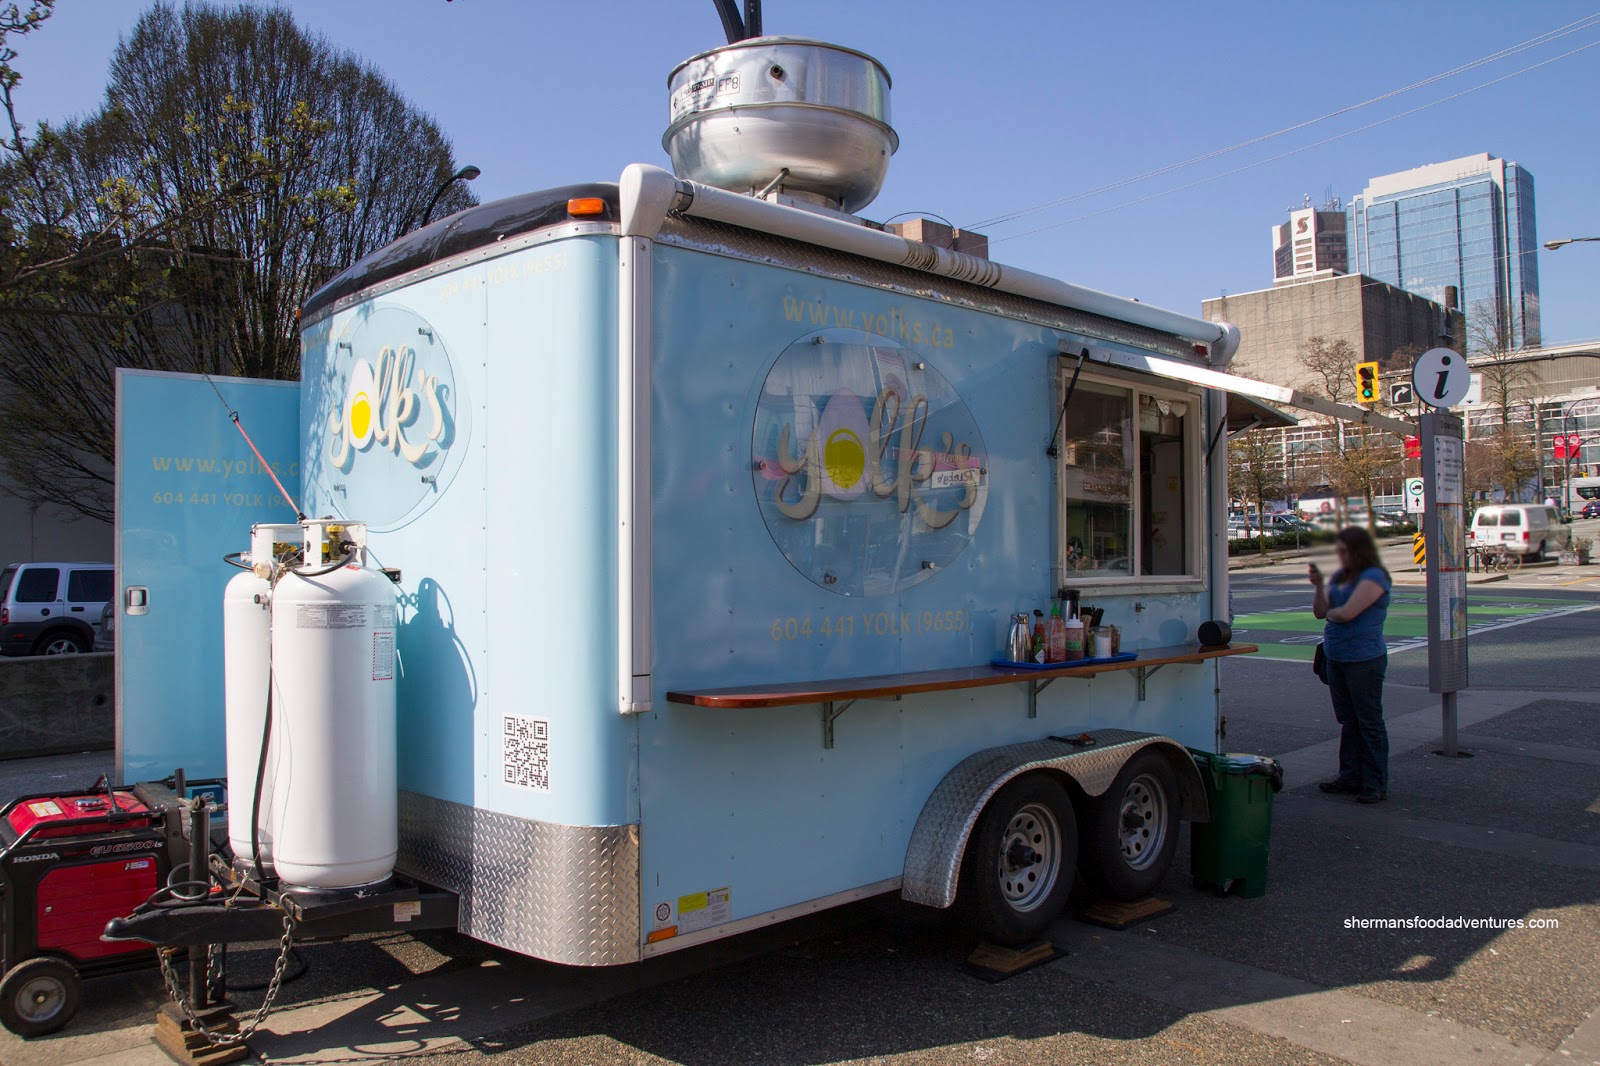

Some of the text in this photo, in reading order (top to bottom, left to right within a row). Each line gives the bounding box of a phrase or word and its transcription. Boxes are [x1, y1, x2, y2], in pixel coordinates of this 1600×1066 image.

[719, 77, 739, 93] EF8
[783, 297, 954, 349] www.yolks.ca
[152, 491, 184, 505] 604
[190, 492, 217, 505] 441
[223, 493, 263, 507] YOLK
[770, 609, 969, 641] 604 441 YOLK (9655)
[12, 852, 61, 864] HONDA
